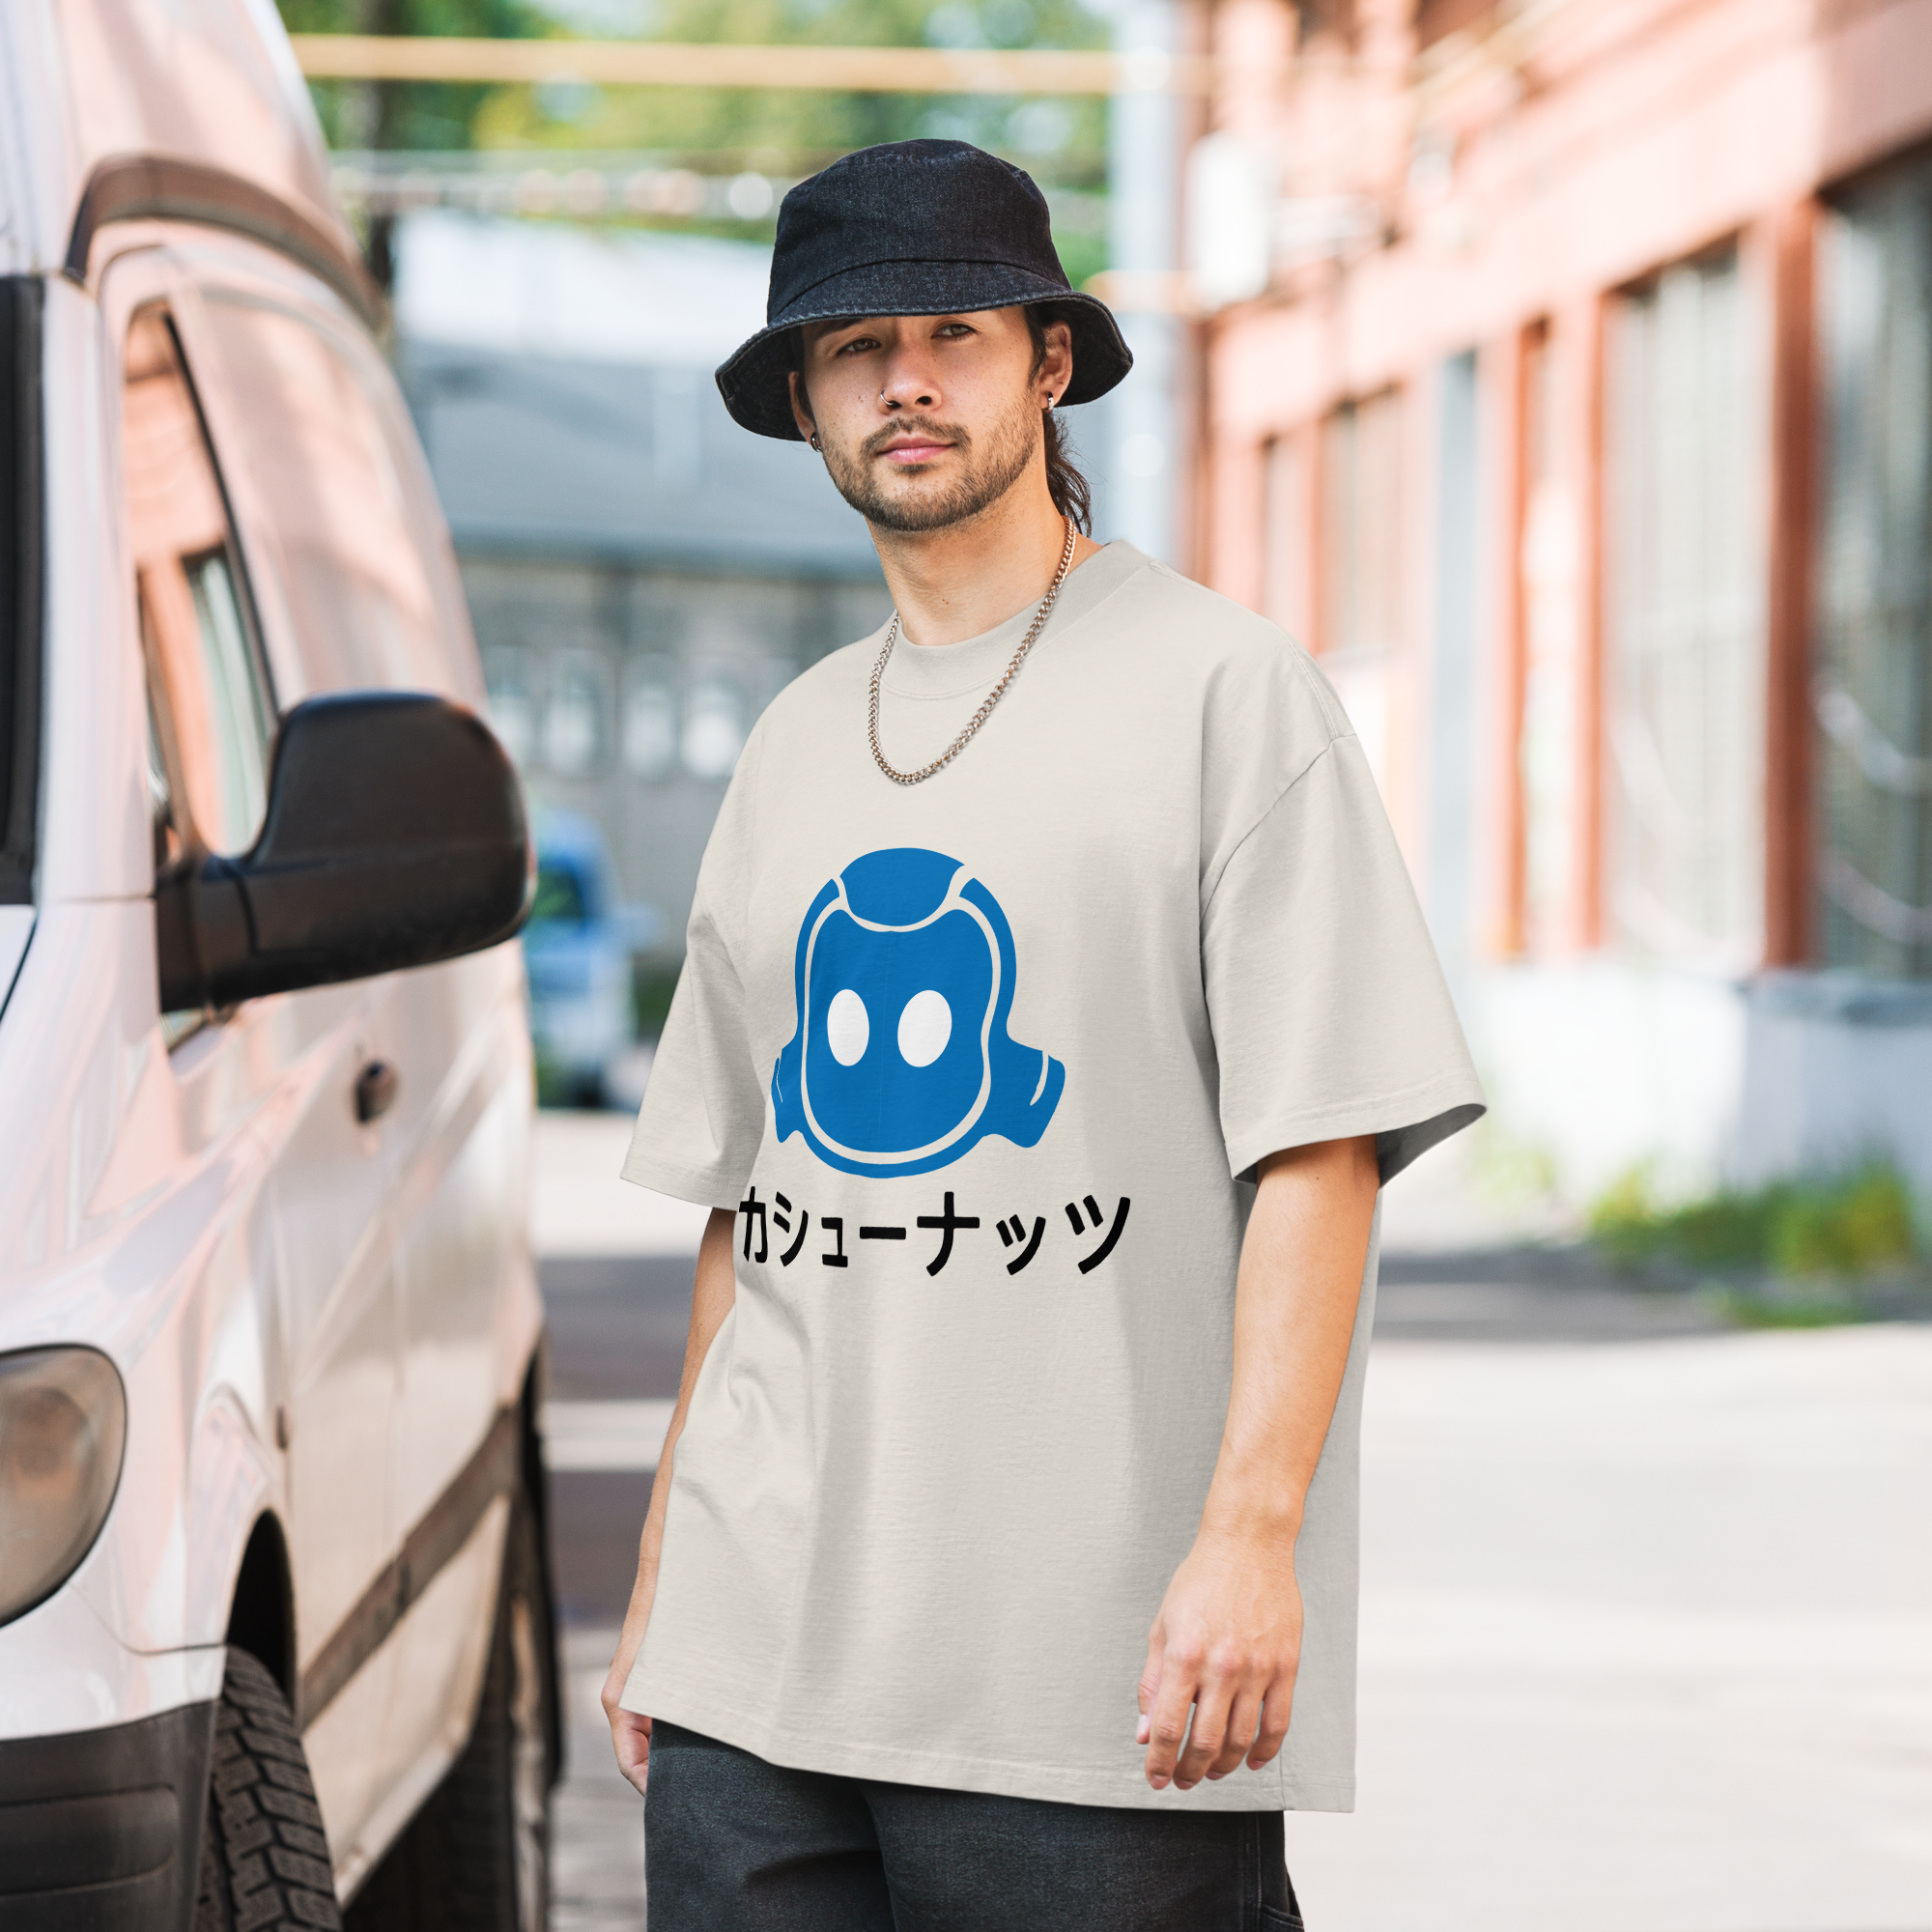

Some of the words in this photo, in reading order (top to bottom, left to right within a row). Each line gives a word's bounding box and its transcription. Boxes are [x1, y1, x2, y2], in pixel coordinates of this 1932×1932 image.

[738, 1185, 1131, 1277] カシューナッツ
